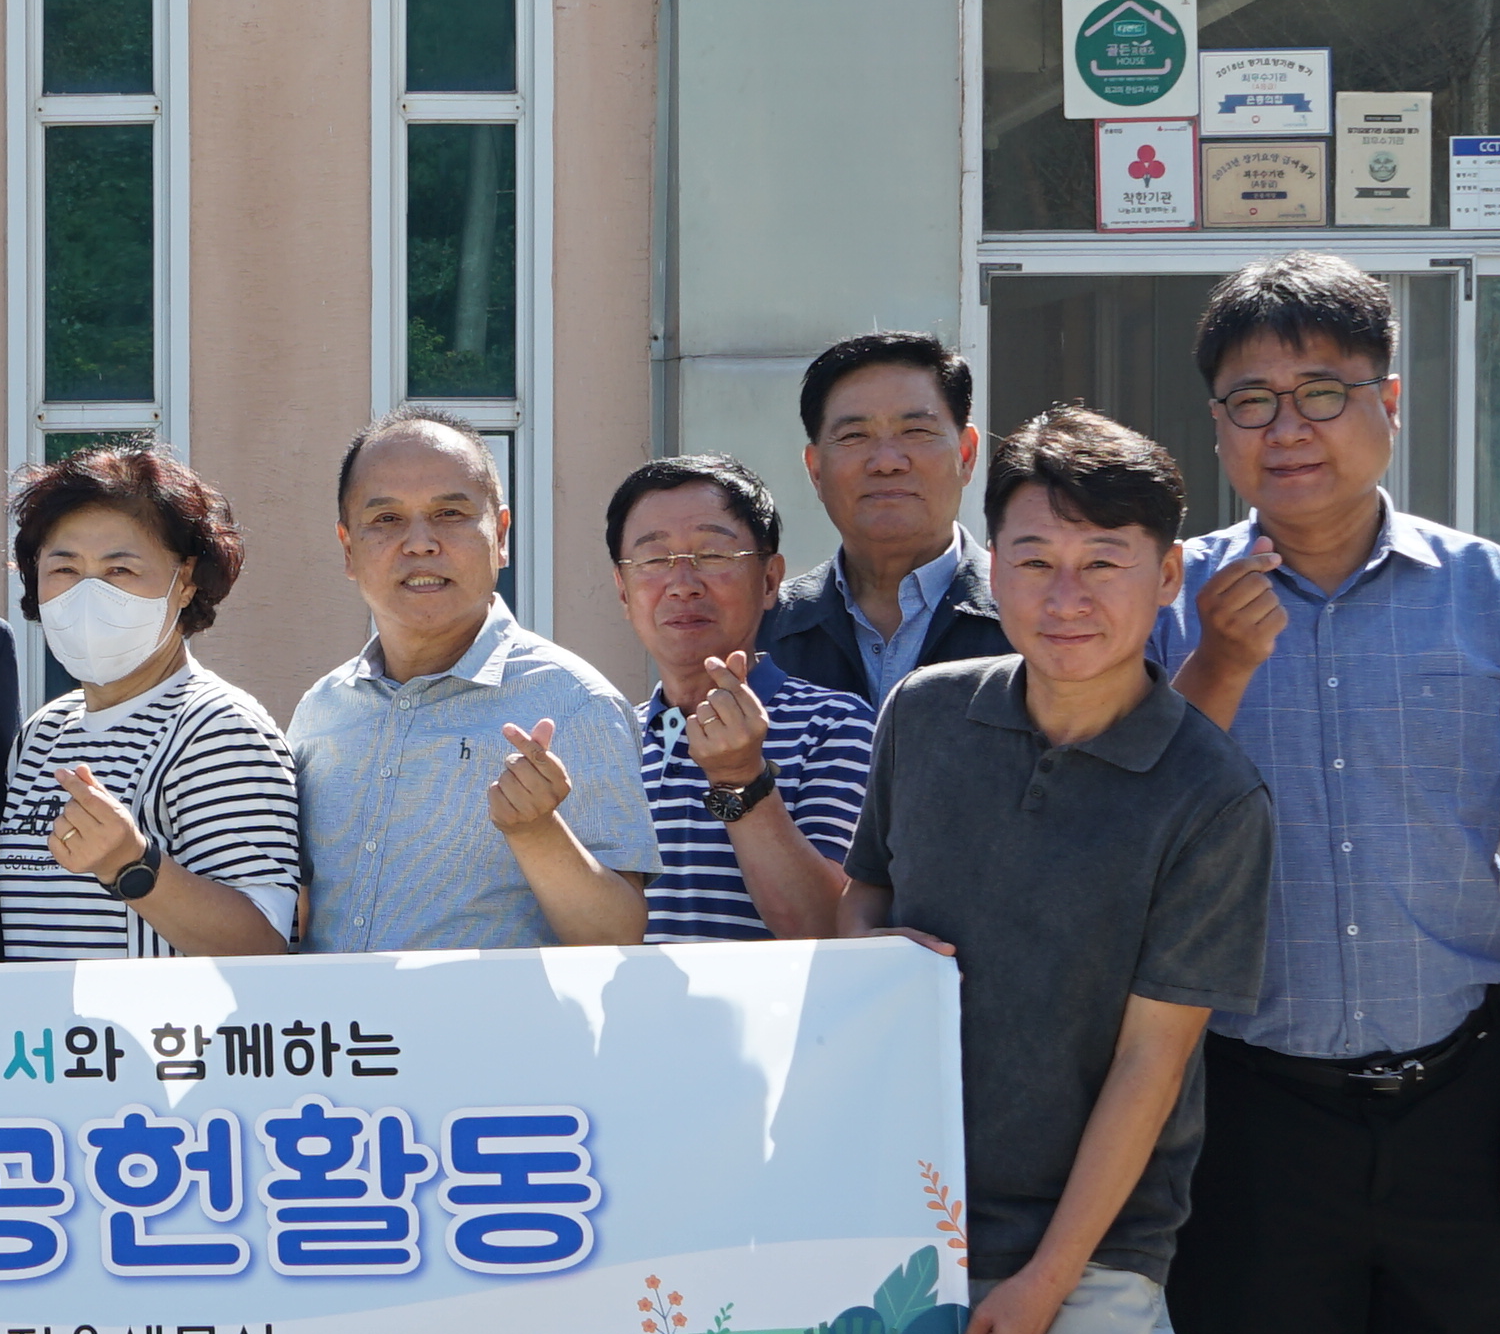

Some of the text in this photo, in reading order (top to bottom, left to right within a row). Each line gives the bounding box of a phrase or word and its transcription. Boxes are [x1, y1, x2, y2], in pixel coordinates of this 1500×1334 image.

[1116, 57, 1146, 66] HOUSE
[1123, 191, 1172, 205] 착한기관
[149, 1019, 401, 1082] 함께하는
